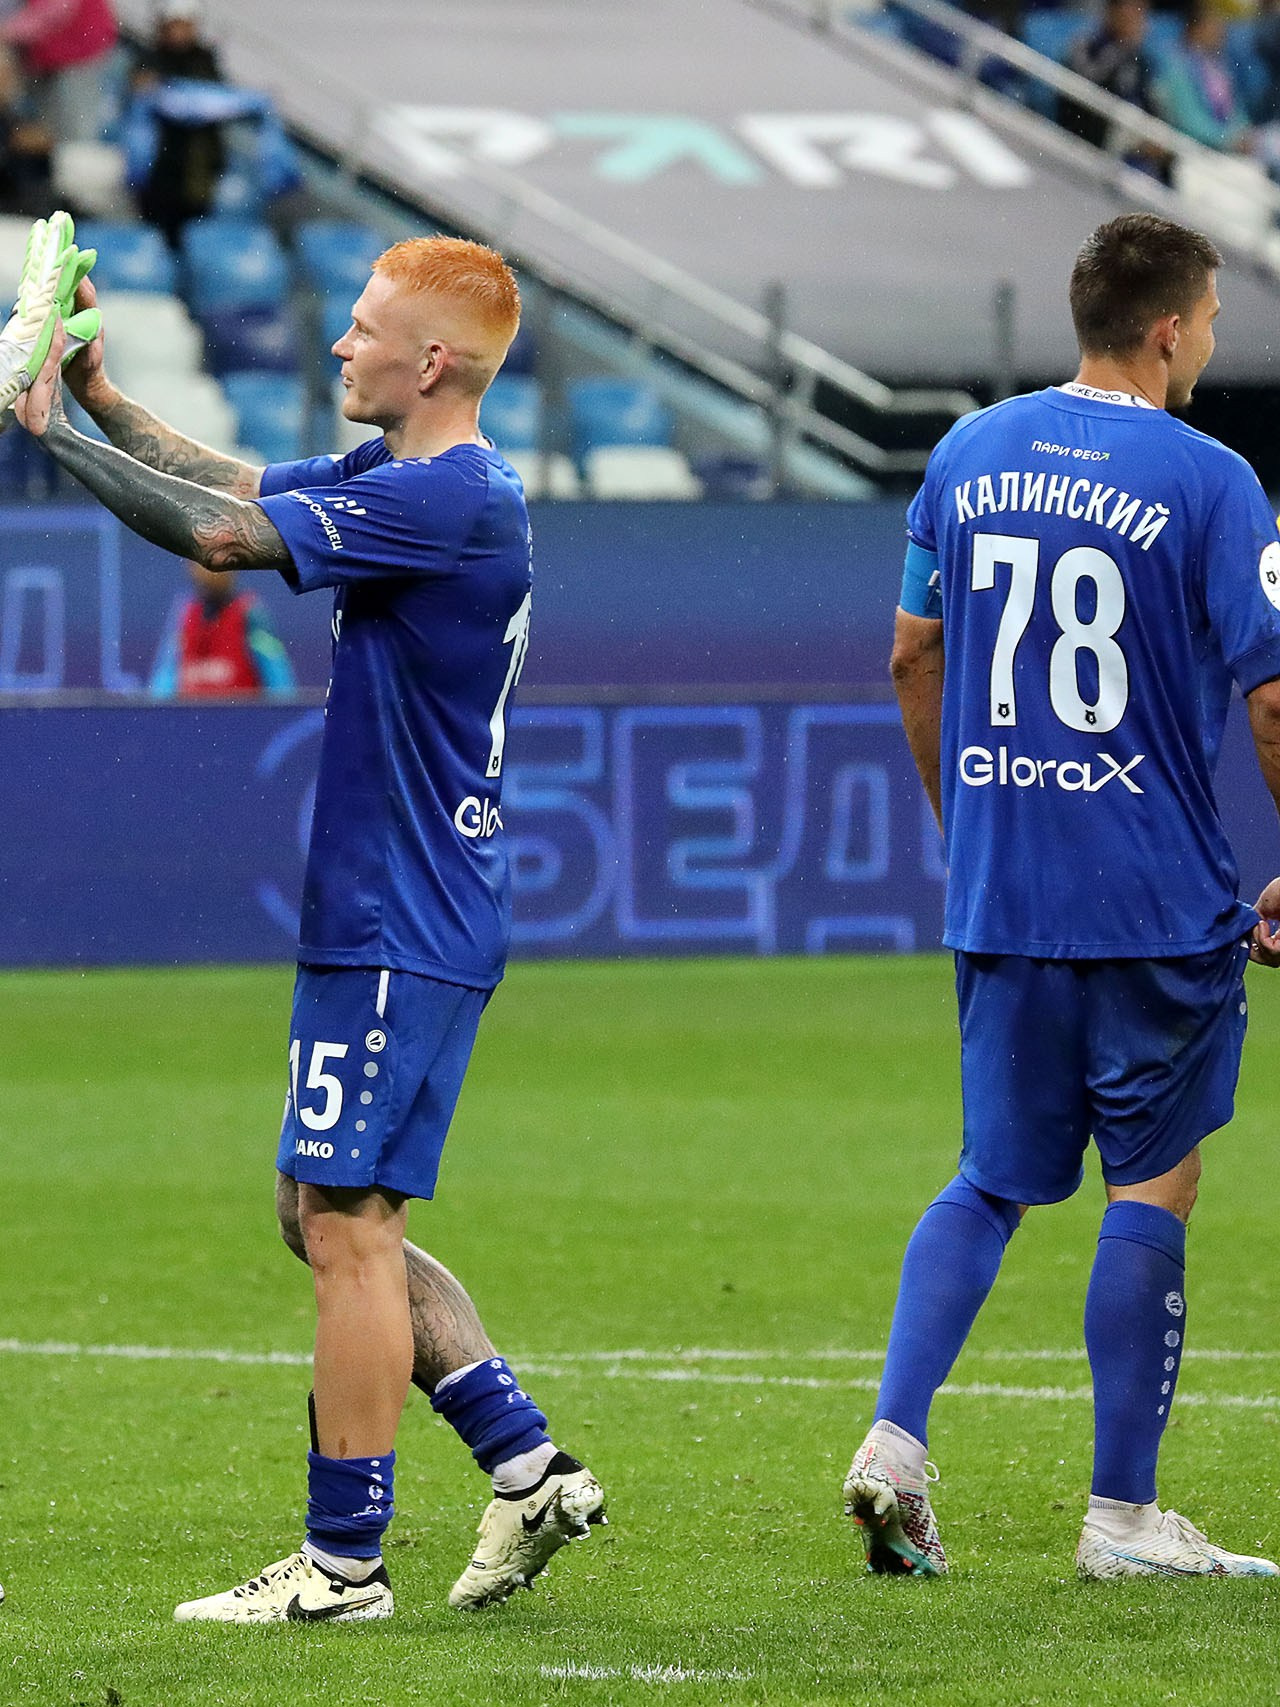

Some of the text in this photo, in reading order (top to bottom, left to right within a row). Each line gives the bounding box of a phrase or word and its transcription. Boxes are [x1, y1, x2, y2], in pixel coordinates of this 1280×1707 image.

[370, 105, 1032, 188] PARI
[1067, 384, 1122, 402] NIKE PRO
[1031, 440, 1070, 457] ПАРИ
[955, 471, 1170, 551] КАЛИНСКИЙ
[972, 533, 1128, 732] 78
[959, 746, 1145, 794] GloraX
[289, 1039, 349, 1131] 15
[296, 1138, 334, 1159] AKO
